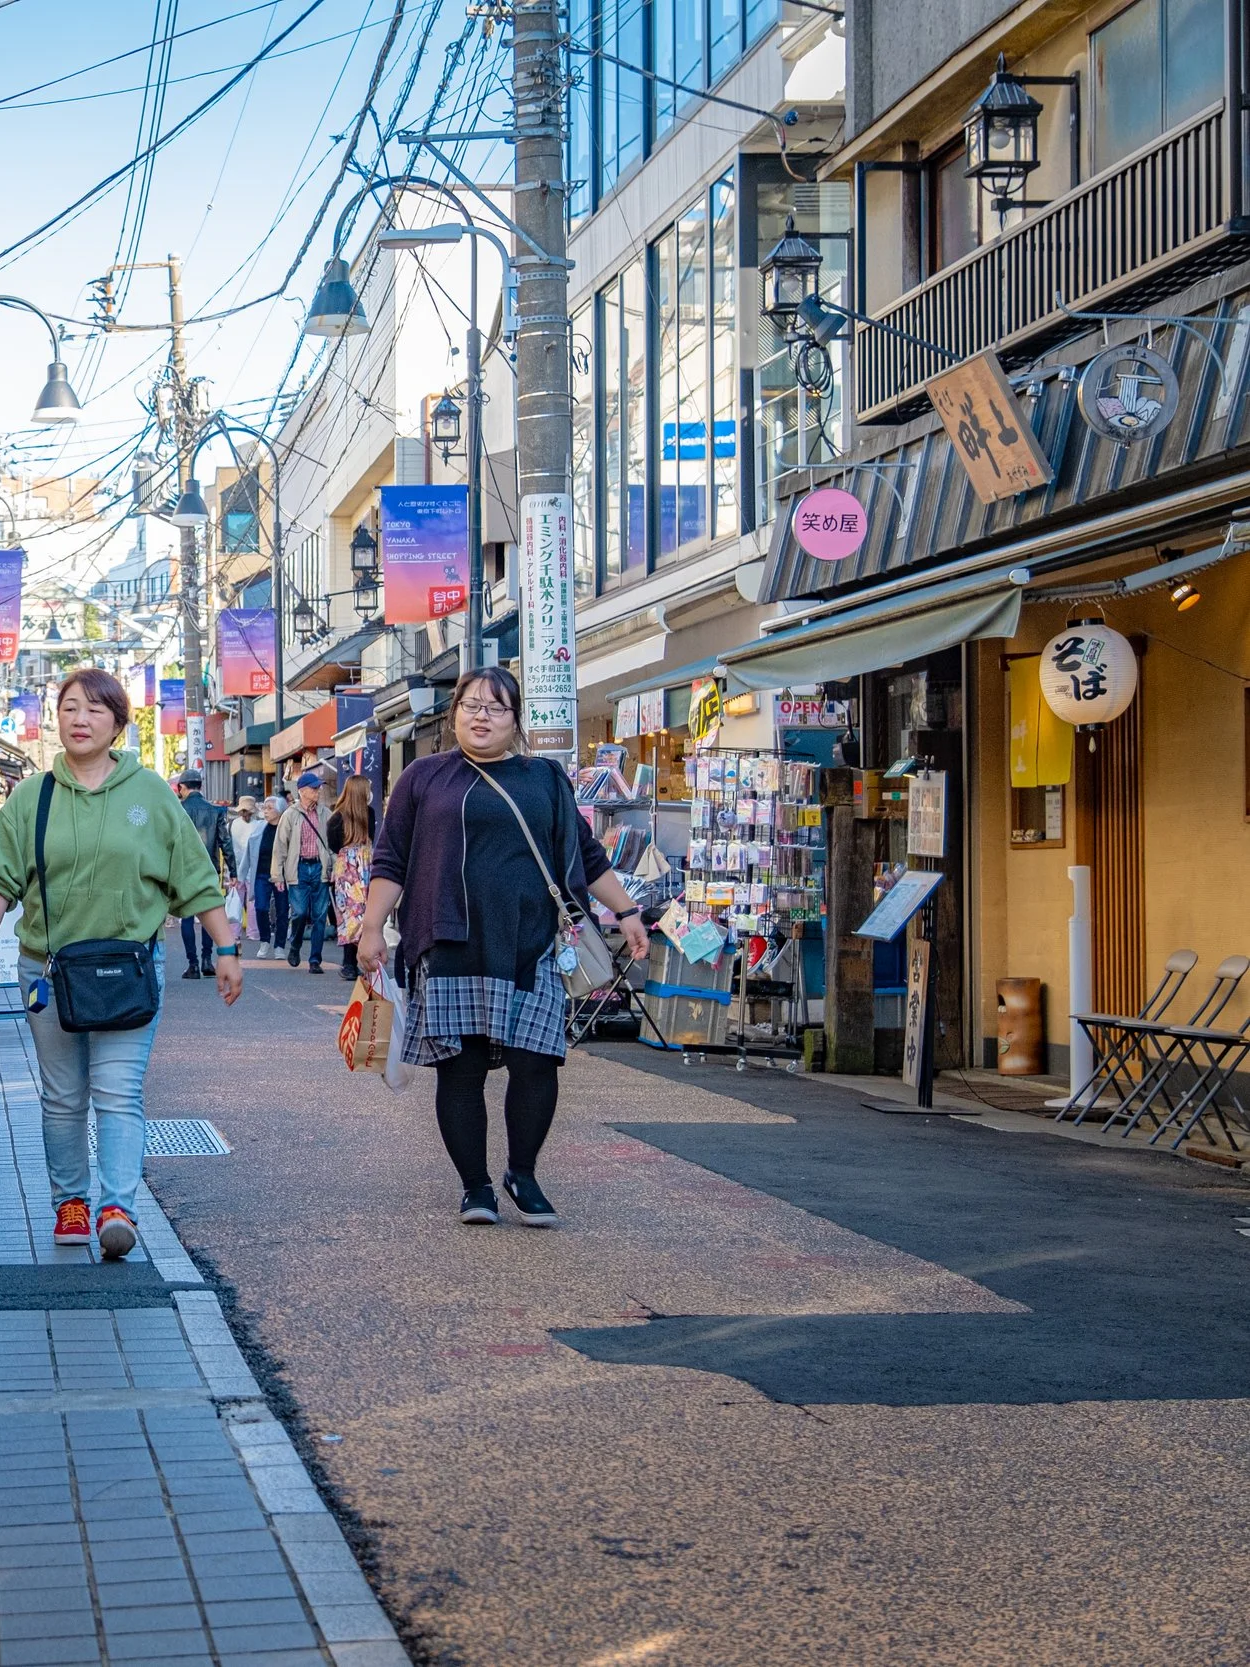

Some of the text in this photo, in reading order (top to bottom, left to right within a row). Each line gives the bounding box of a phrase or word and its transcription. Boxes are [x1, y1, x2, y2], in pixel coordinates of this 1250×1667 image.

[958, 392, 1019, 479] 畔上
[802, 512, 859, 533] 笑め屋
[433, 590, 460, 602] 谷中
[539, 514, 555, 660] エミング千駄木クリニック
[1052, 636, 1108, 701] そば
[780, 701, 821, 713] OPEN
